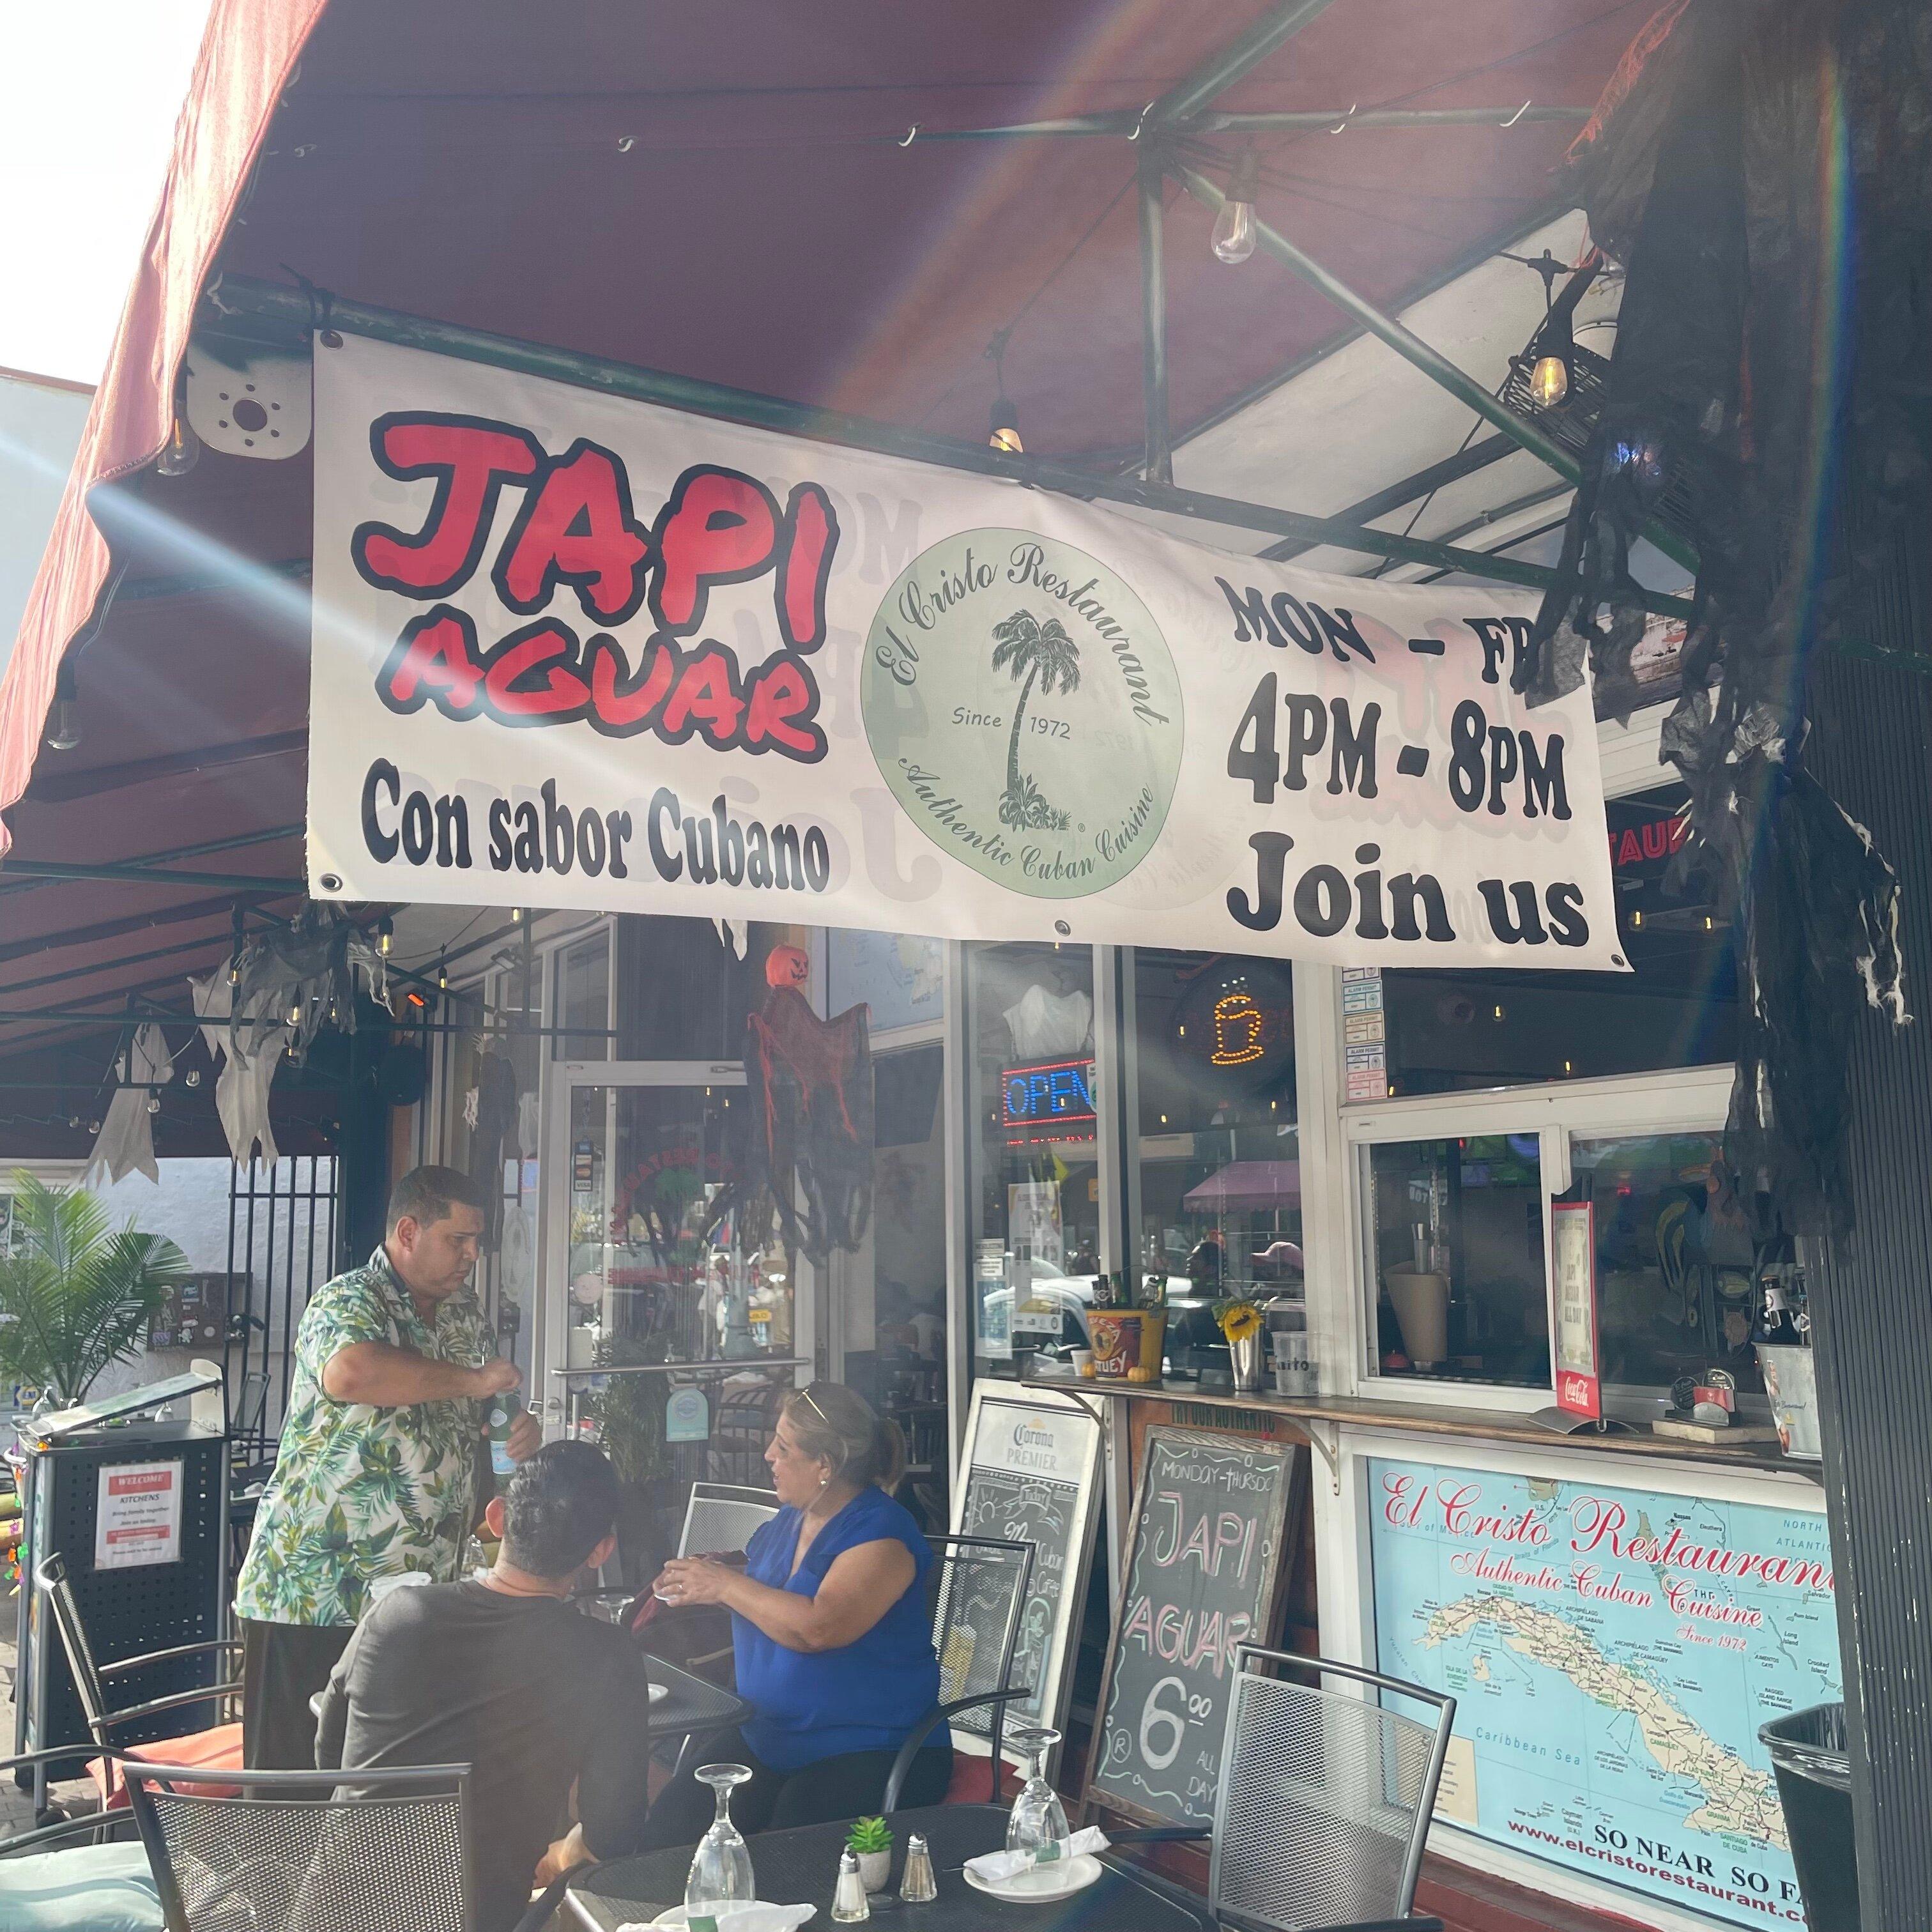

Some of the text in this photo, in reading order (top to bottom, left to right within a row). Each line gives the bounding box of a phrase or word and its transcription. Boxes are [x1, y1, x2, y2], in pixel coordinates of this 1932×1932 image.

[351, 411, 840, 654] JAPI
[876, 542, 1170, 727] El Cristo Restaurant
[1215, 576, 1376, 664] MON
[374, 604, 829, 764] AGUAR
[952, 707, 1002, 728] Since
[1030, 717, 1071, 740] 1972
[1227, 671, 1381, 804] 4PM
[1448, 700, 1572, 821] 8PM
[361, 758, 831, 893] Con sabor Cubano
[899, 758, 1153, 880] Authentic Cuban Cuisine
[1226, 831, 1590, 947] Join us
[1006, 1070, 1091, 1114] OPEN
[1014, 1422, 1054, 1448] Corona
[118, 1475, 165, 1485] WELCOME
[1007, 1448, 1058, 1471] PREMIER
[120, 1494, 160, 1503] KITCHENS
[1383, 1472, 1429, 1526] El
[1436, 1478, 1552, 1545] Cristo
[1151, 1491, 1257, 1590] JAPI
[1783, 1519, 1821, 1532] NORTH
[1451, 1545, 1761, 1628] Authentic Cuban Cuisine
[1123, 1595, 1251, 1680] AGUAR
[1676, 1623, 1747, 1653] Since 1972
[1784, 1630, 1798, 1639] Long
[1807, 1659, 1830, 1668] Crooked
[1811, 1666, 1827, 1675] Island
[1476, 1726, 1581, 1765] Caribbean Sea
[1186, 1777, 1218, 1803] DAY
[1594, 1824, 1628, 1850] SO
[1635, 1836, 1715, 1878] NEAR
[1731, 1866, 1770, 1893] SO
[1721, 1832, 1748, 1846] SANTIAGO
